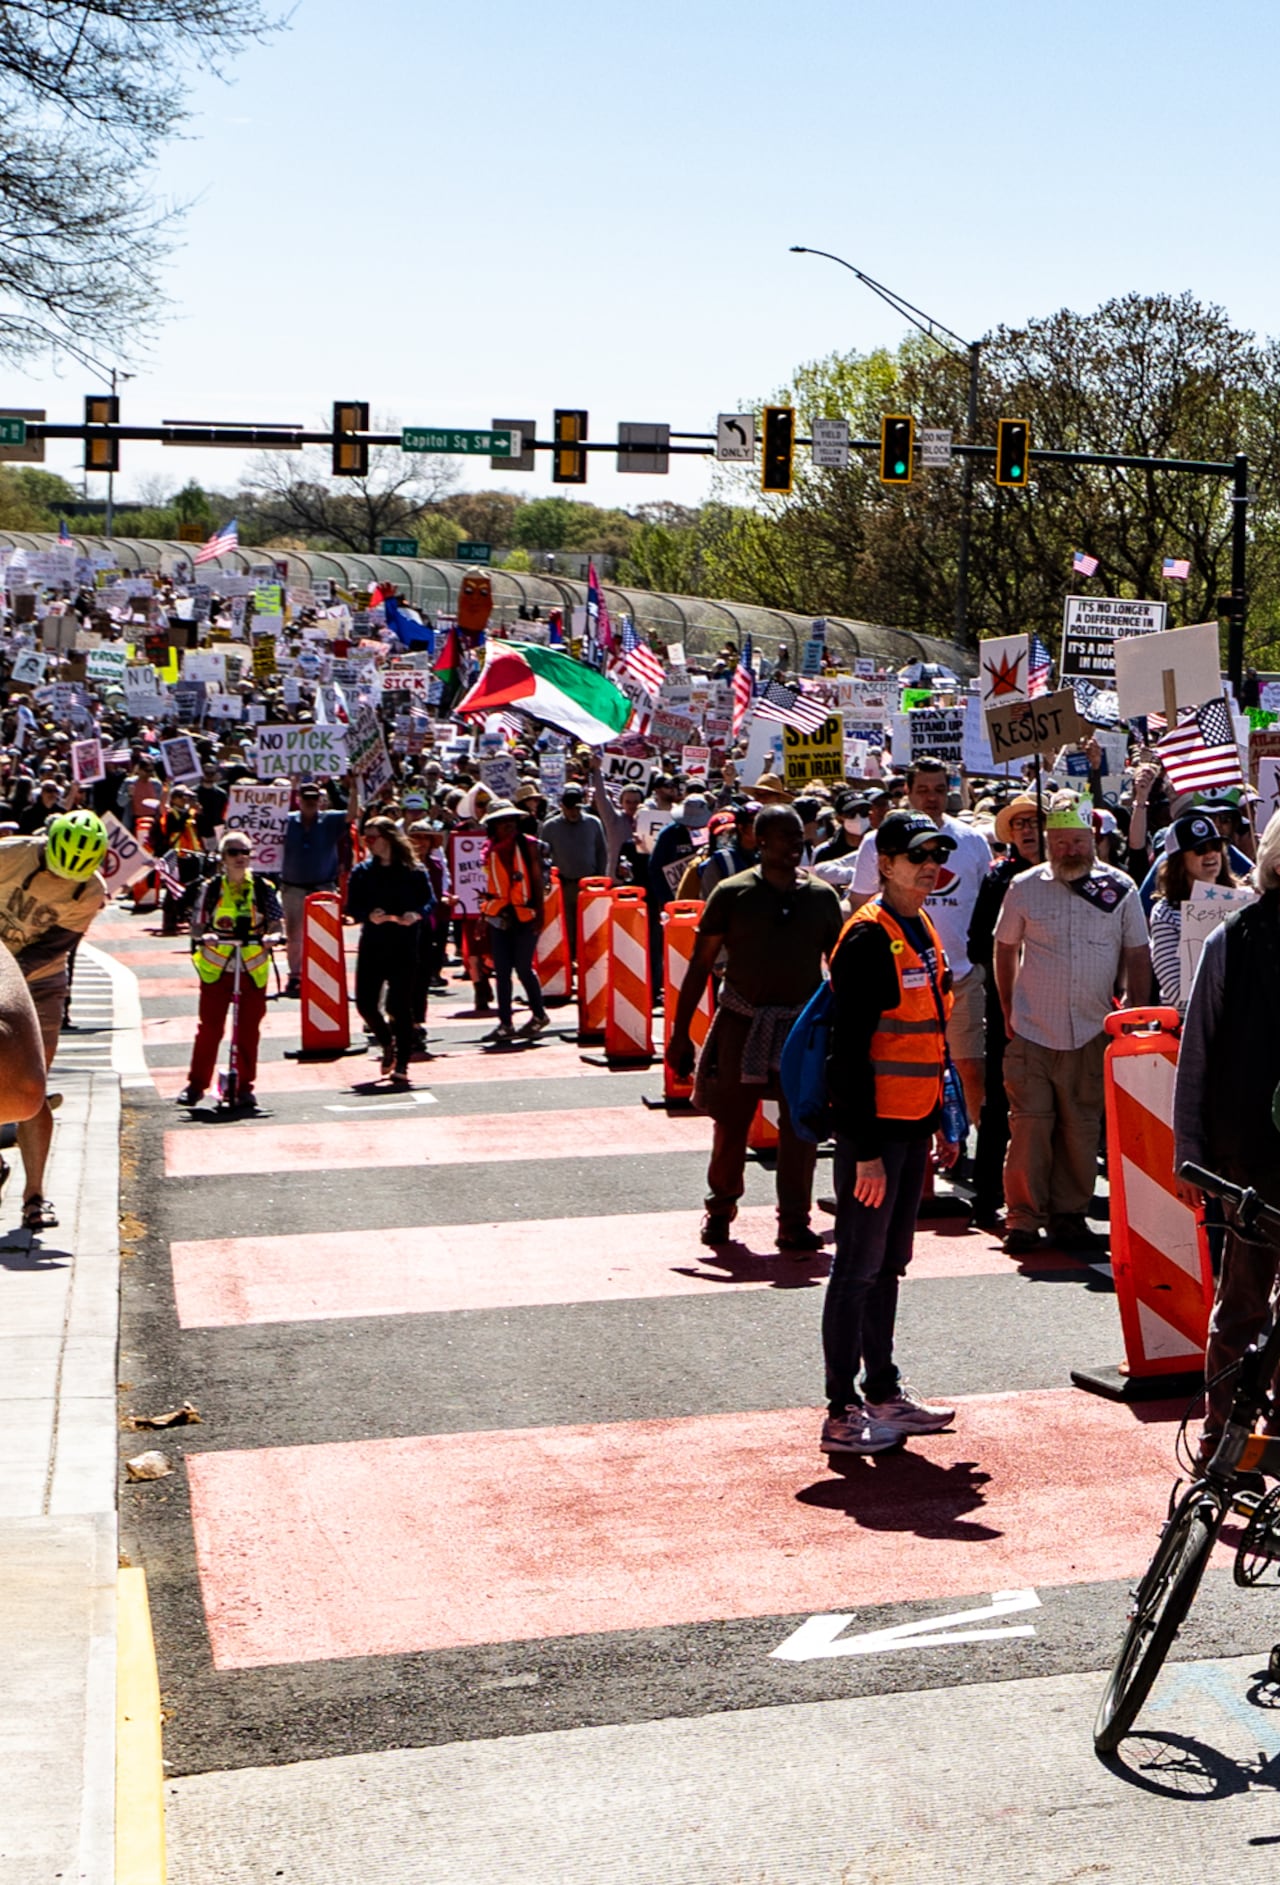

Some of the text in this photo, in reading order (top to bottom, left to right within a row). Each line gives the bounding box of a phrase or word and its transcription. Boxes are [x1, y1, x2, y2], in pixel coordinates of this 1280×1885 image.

[404, 432, 490, 451] Capitol Sq SW
[1078, 603, 1149, 616] IT'S NO LONGER
[1076, 614, 1154, 627] A DIFFERENCE IN
[1070, 625, 1115, 636] POLITICAL
[1068, 641, 1086, 654] IT'S
[1088, 643, 1095, 654] A
[1079, 656, 1090, 668] IN
[383, 678, 425, 690] SICK
[911, 721, 963, 732] STAND UP
[992, 709, 1064, 752] RESIST
[260, 734, 283, 750] NO
[911, 733, 963, 744] TO TRUMP
[262, 753, 341, 774] TATORS
[610, 758, 644, 780] NO
[788, 760, 842, 778] ON IRAN
[231, 788, 289, 808] TRUMP
[248, 805, 273, 818] IS
[227, 815, 289, 833] OPENLY
